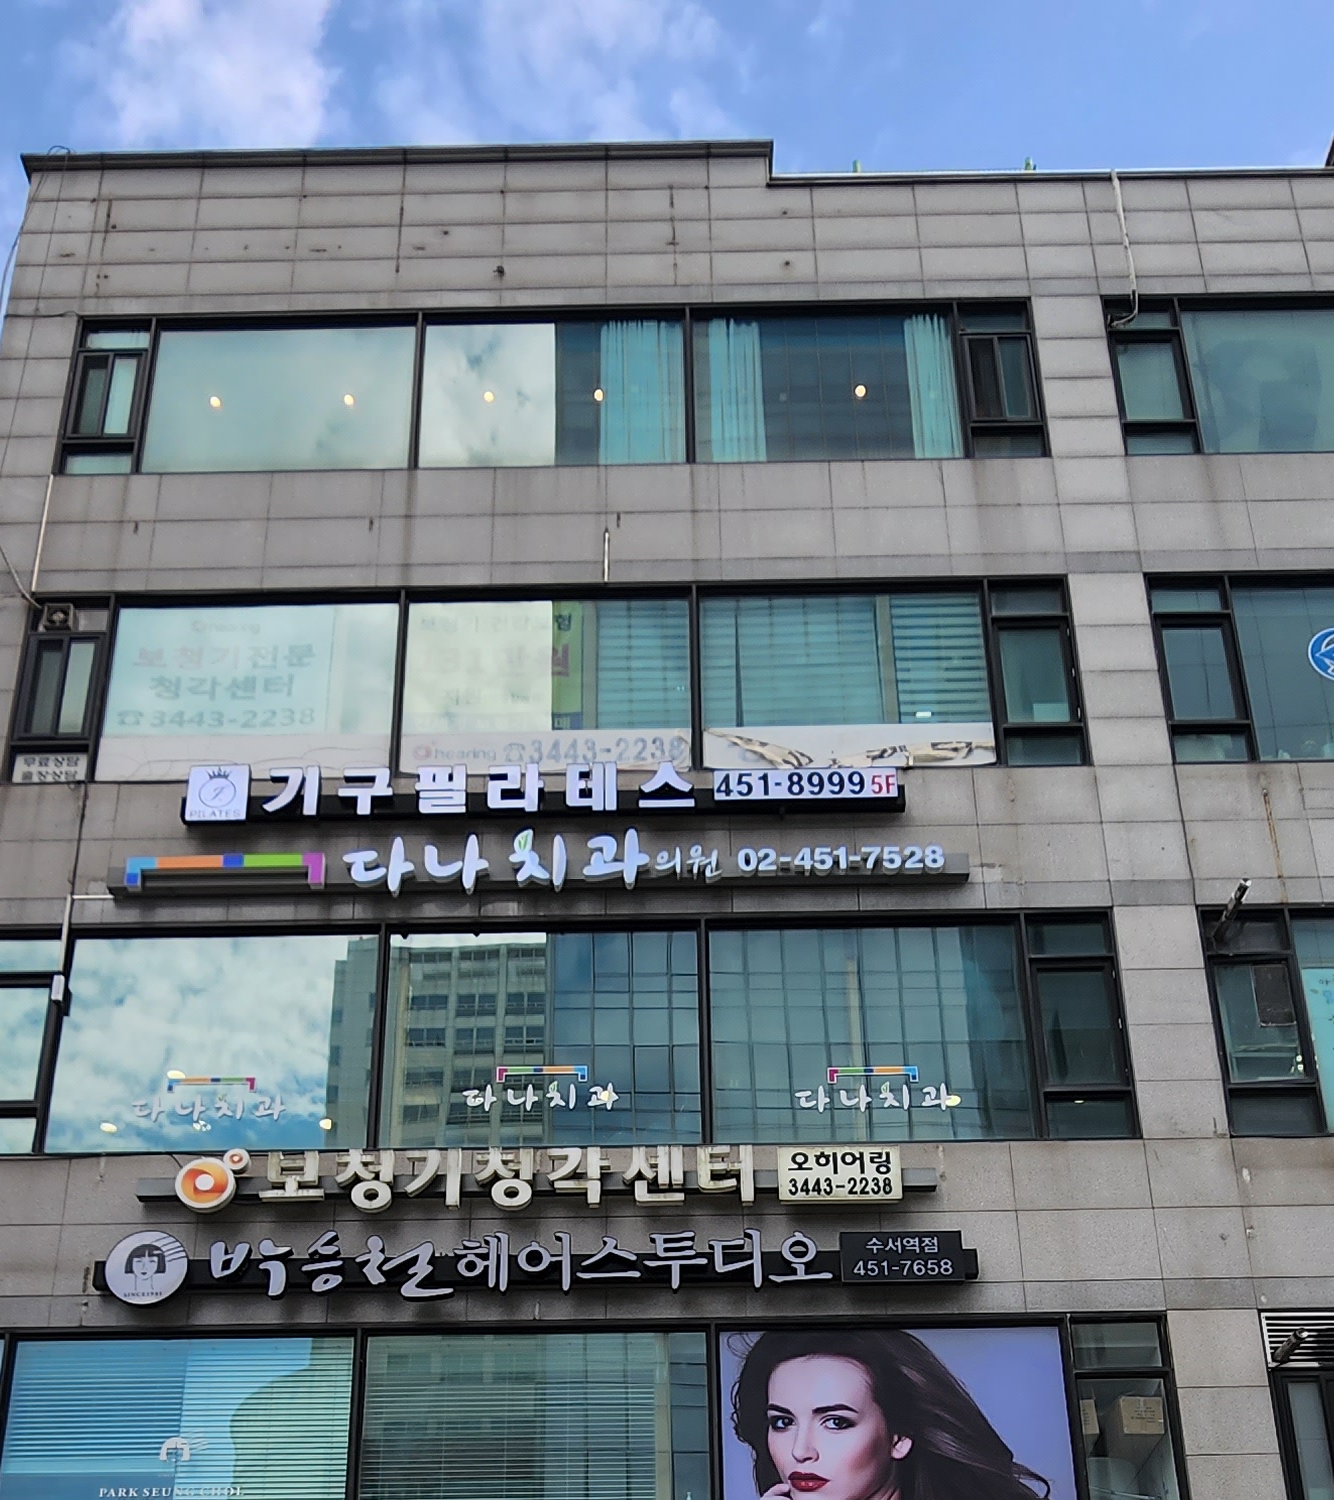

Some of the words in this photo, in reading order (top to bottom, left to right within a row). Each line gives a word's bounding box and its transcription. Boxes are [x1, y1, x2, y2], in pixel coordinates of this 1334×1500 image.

[716, 771, 865, 798] 451-8999
[871, 774, 897, 796] 5F
[342, 828, 650, 895] 다나치과
[655, 843, 722, 884] 의원
[737, 847, 945, 876] 02-451-7528
[132, 1093, 287, 1121] 다나치과
[462, 1082, 619, 1112] 다나치과
[794, 1082, 953, 1113] 다나치과
[258, 1147, 755, 1212] 보청기청각센터
[787, 1150, 893, 1176] 오히어링
[787, 1177, 894, 1197] 3443-2238
[865, 1236, 940, 1255] 수서역점
[852, 1258, 954, 1278] 451-7658
[98, 1487, 139, 1498] PARK
